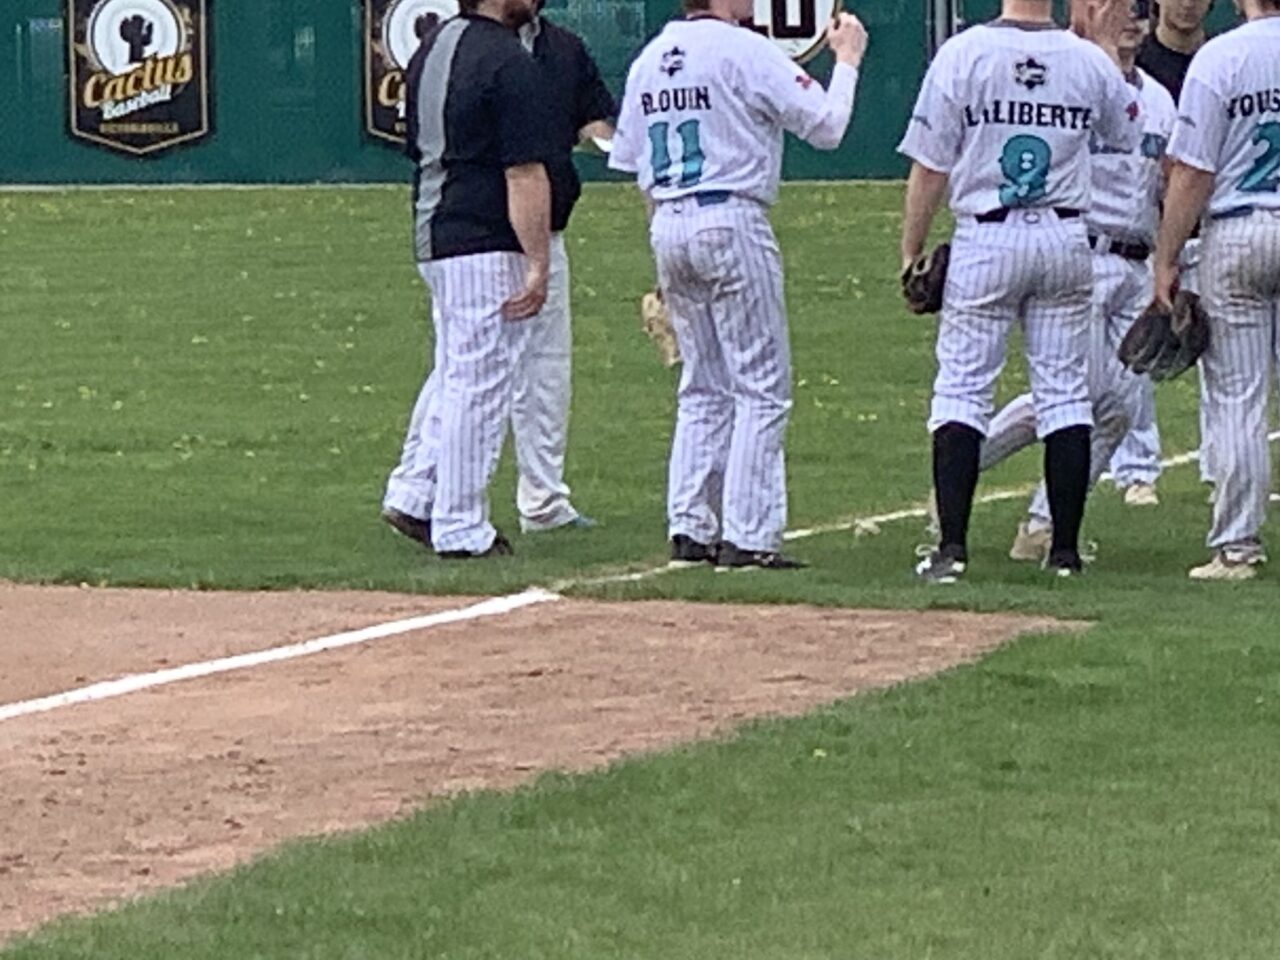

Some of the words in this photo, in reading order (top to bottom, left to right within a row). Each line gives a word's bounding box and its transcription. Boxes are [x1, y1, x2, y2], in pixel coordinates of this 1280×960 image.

[84, 53, 192, 109] Cactus
[100, 83, 172, 120] Baseball
[648, 119, 706, 188] 11
